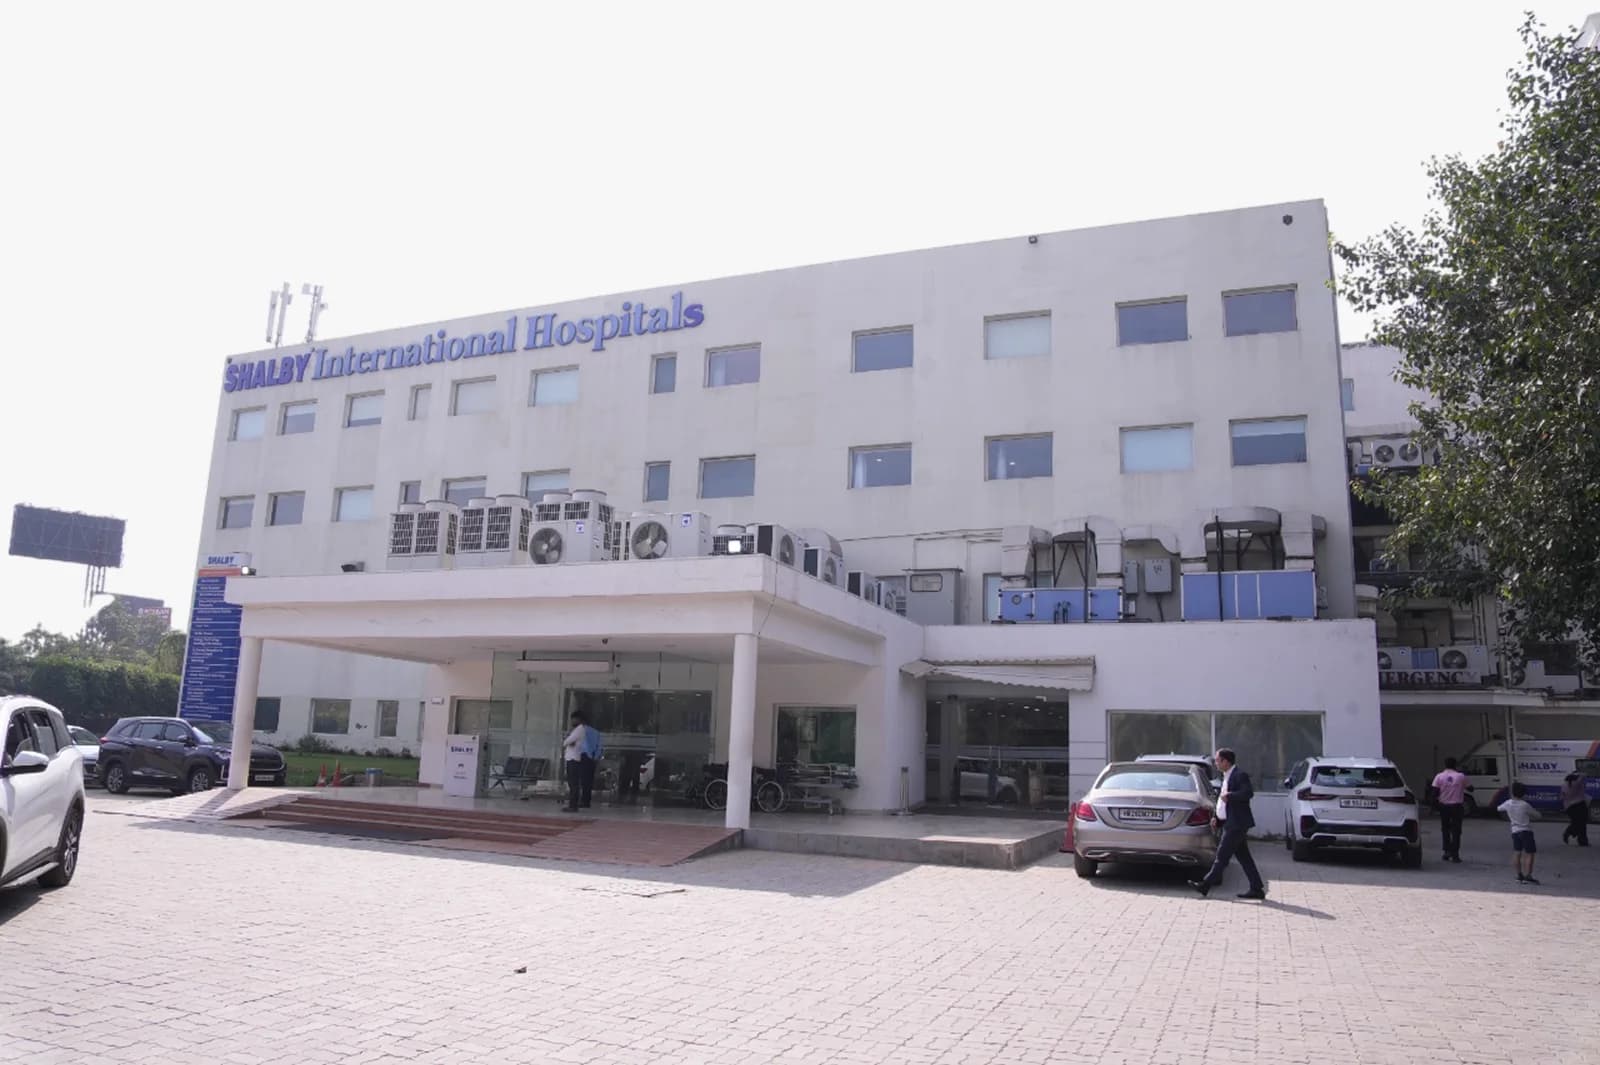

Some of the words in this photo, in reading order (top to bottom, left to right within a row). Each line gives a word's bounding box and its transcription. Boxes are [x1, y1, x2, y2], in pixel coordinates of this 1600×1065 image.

[223, 352, 313, 393] SHALBY
[311, 315, 518, 381] International
[523, 290, 705, 352] Hospitals
[207, 556, 234, 565] SHALBY
[1379, 671, 1478, 685] ERGENCY
